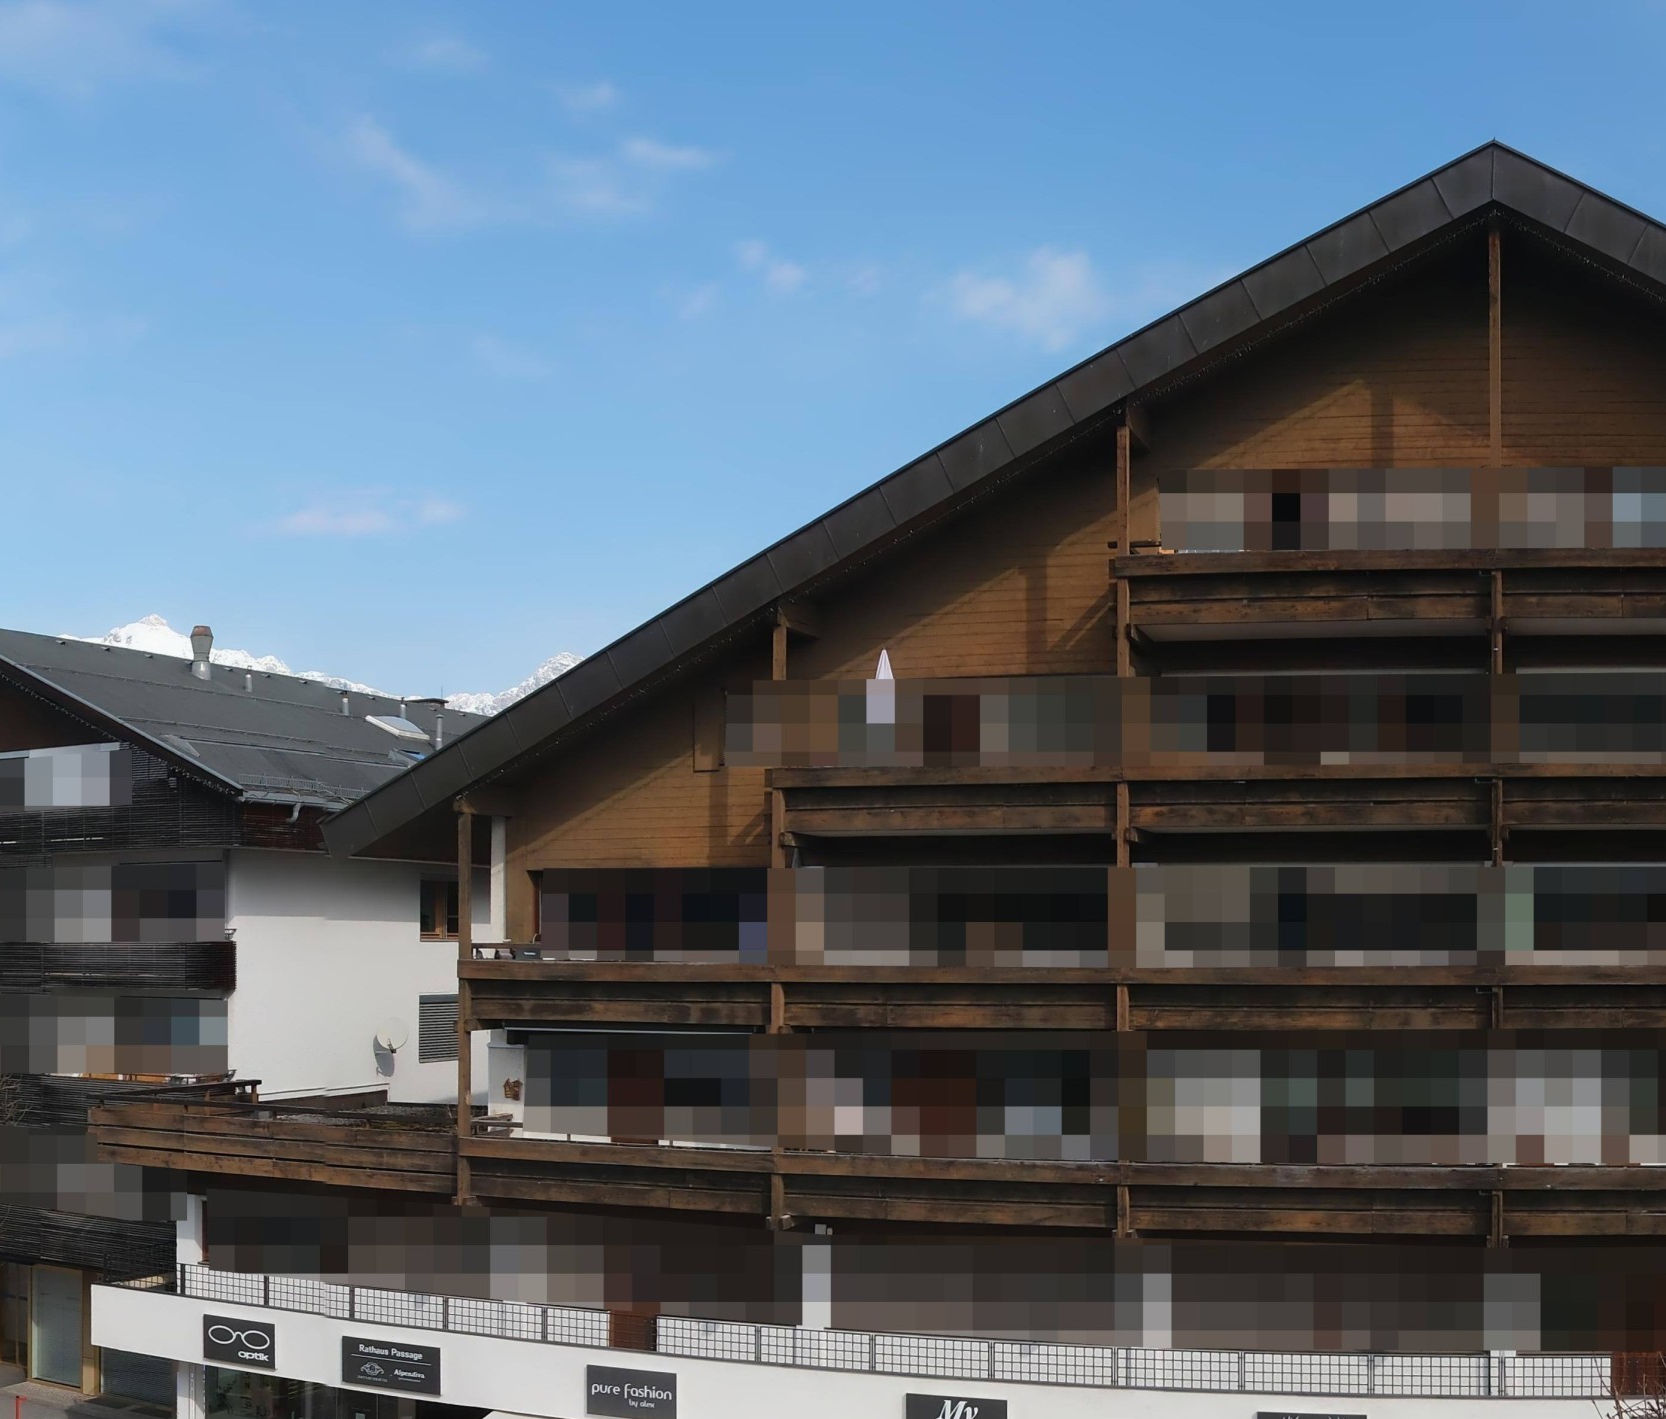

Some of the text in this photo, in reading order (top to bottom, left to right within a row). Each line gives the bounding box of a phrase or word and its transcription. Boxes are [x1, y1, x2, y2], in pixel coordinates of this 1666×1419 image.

[238, 1350, 269, 1362] optik
[358, 1344, 423, 1361] Rathaus Passage
[591, 1383, 621, 1396] pure
[628, 1399, 638, 1408] by
